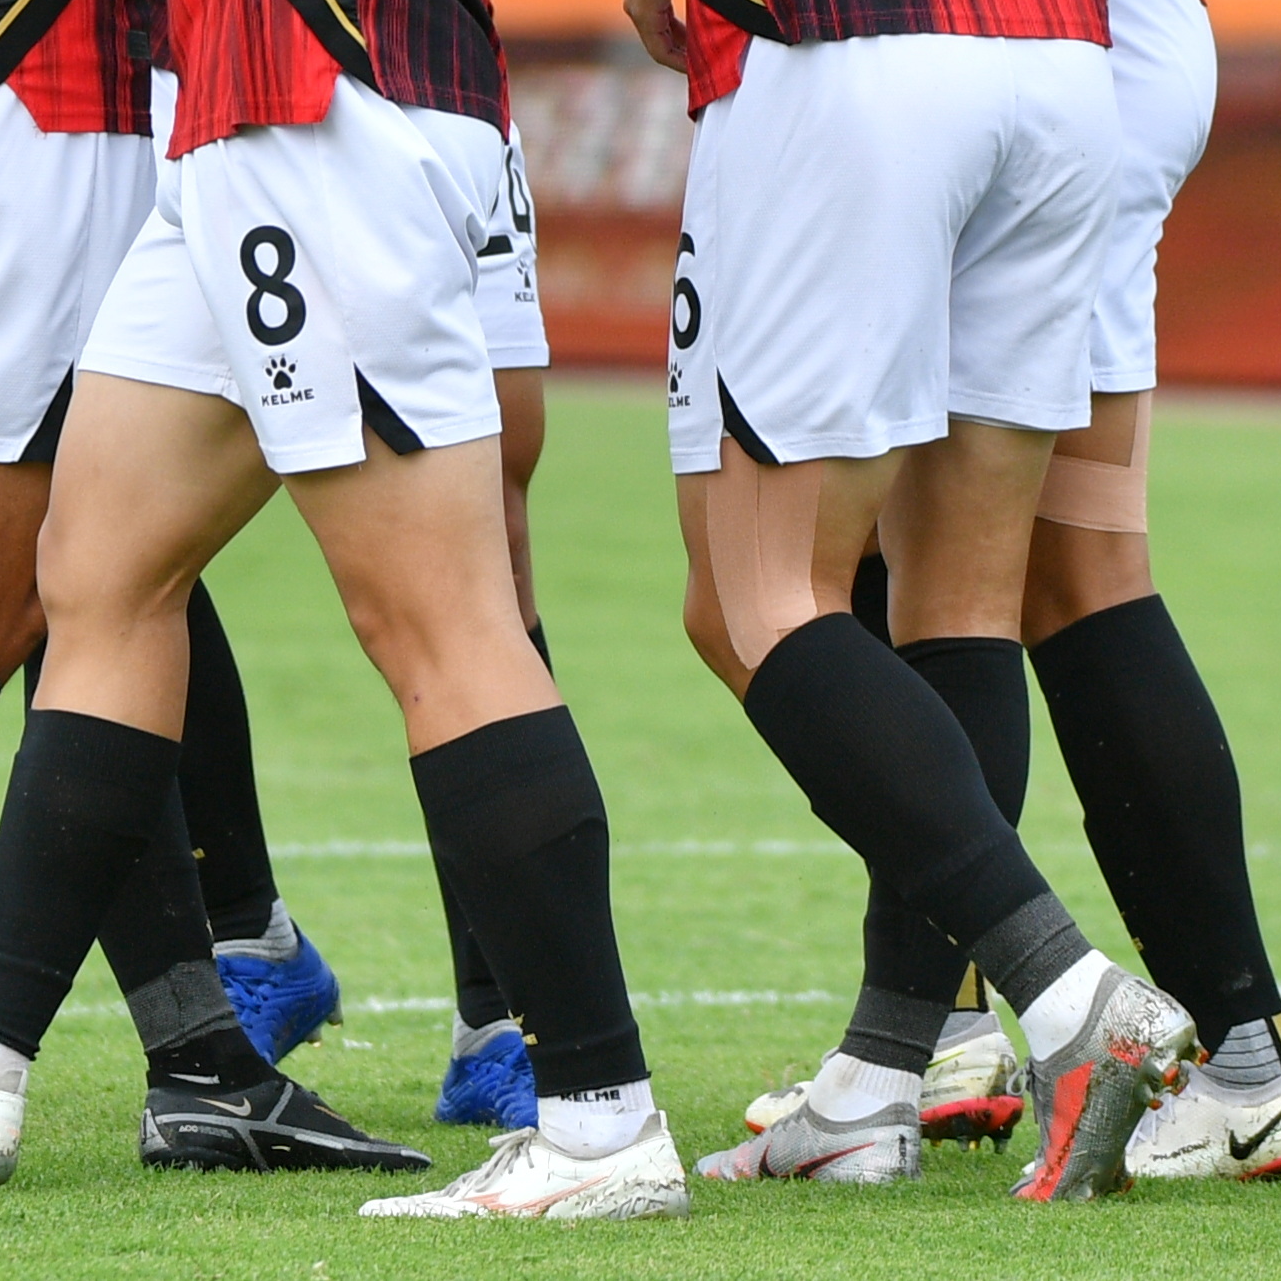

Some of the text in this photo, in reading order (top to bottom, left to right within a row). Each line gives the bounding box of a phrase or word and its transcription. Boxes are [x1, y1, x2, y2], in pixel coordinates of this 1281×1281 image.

[240, 225, 306, 346] 8
[261, 388, 315, 407] KELME
[559, 1089, 621, 1103] KELME
